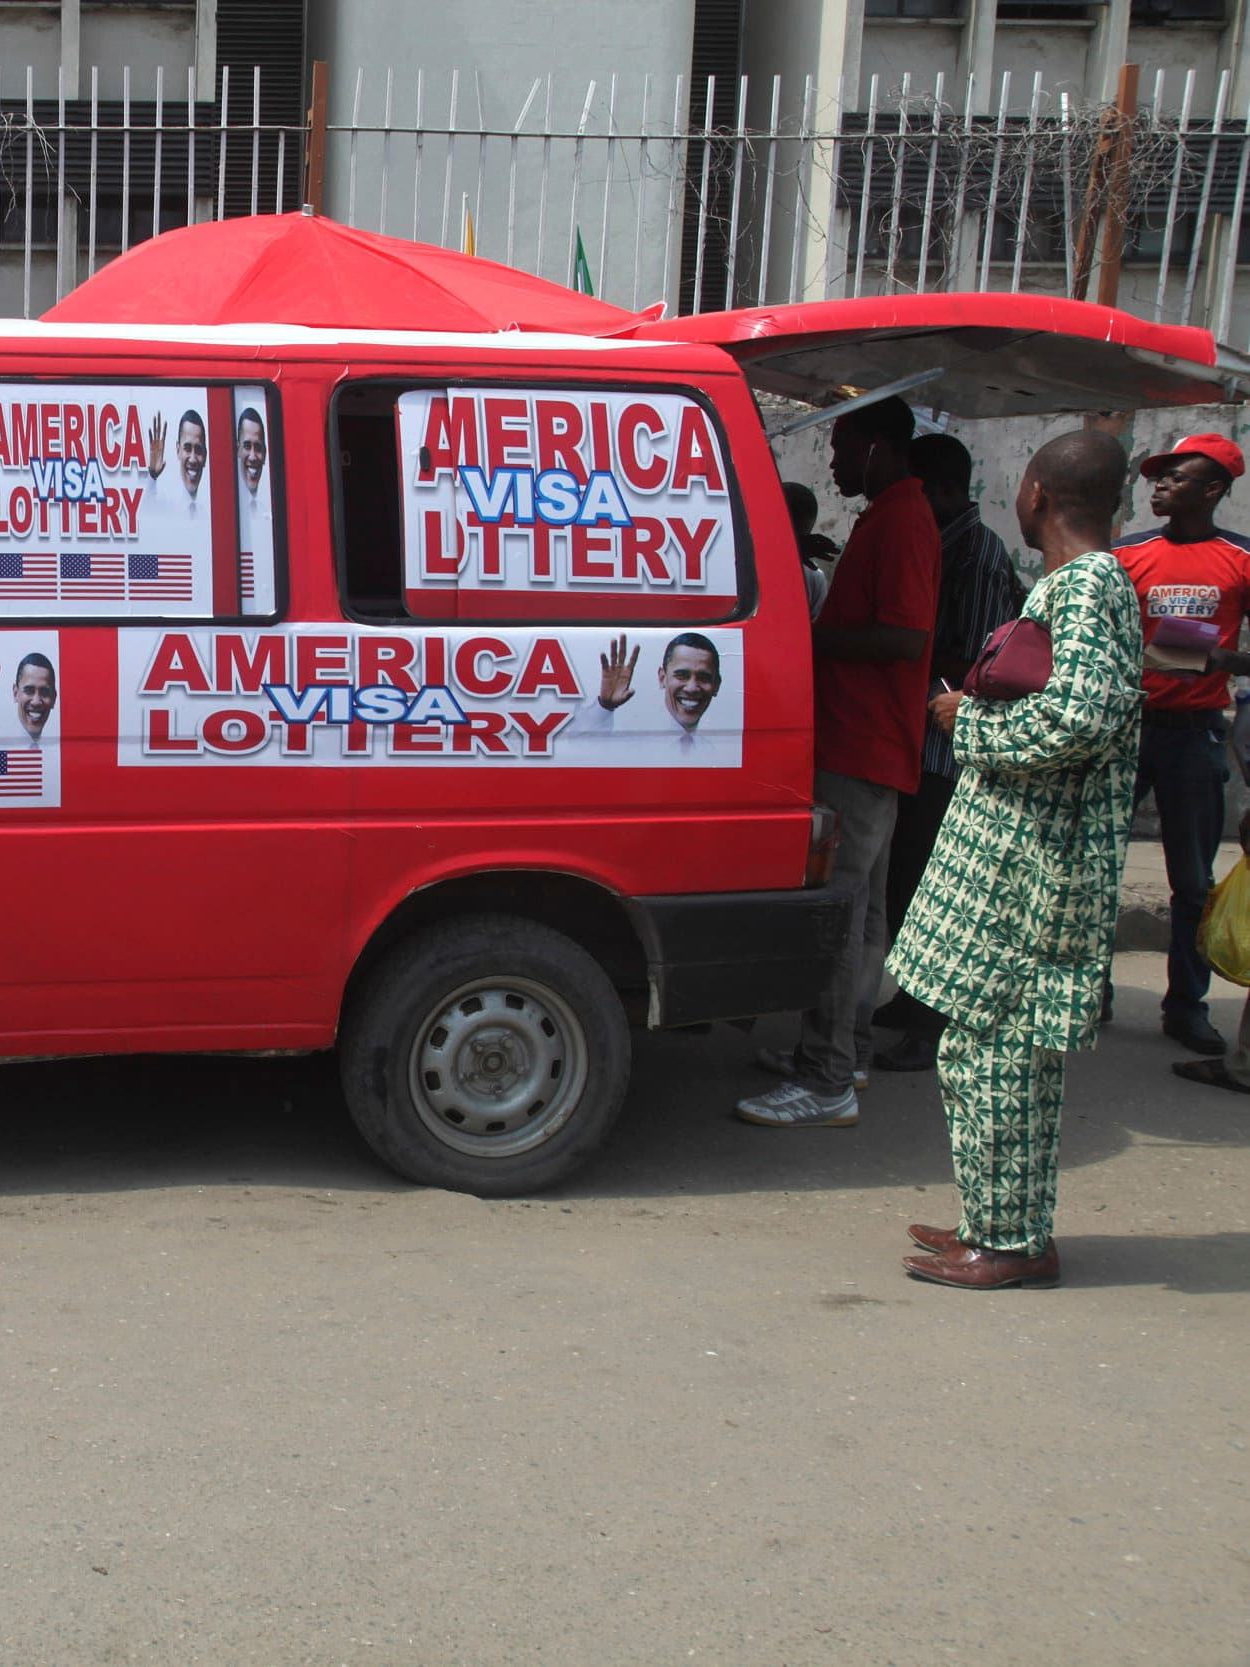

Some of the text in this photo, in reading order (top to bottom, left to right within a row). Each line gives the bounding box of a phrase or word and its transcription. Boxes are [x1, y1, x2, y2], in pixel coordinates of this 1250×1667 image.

[30, 457, 107, 502] VISA
[458, 465, 634, 527] VISA
[423, 508, 719, 581] LTTERY
[1150, 587, 1218, 598] AMERICA
[1150, 605, 1216, 615] LOTTERY
[1169, 597, 1197, 605] VISA
[142, 633, 581, 695] AMERICA
[263, 684, 471, 724] VISA
[148, 710, 571, 752] LOTTERY
